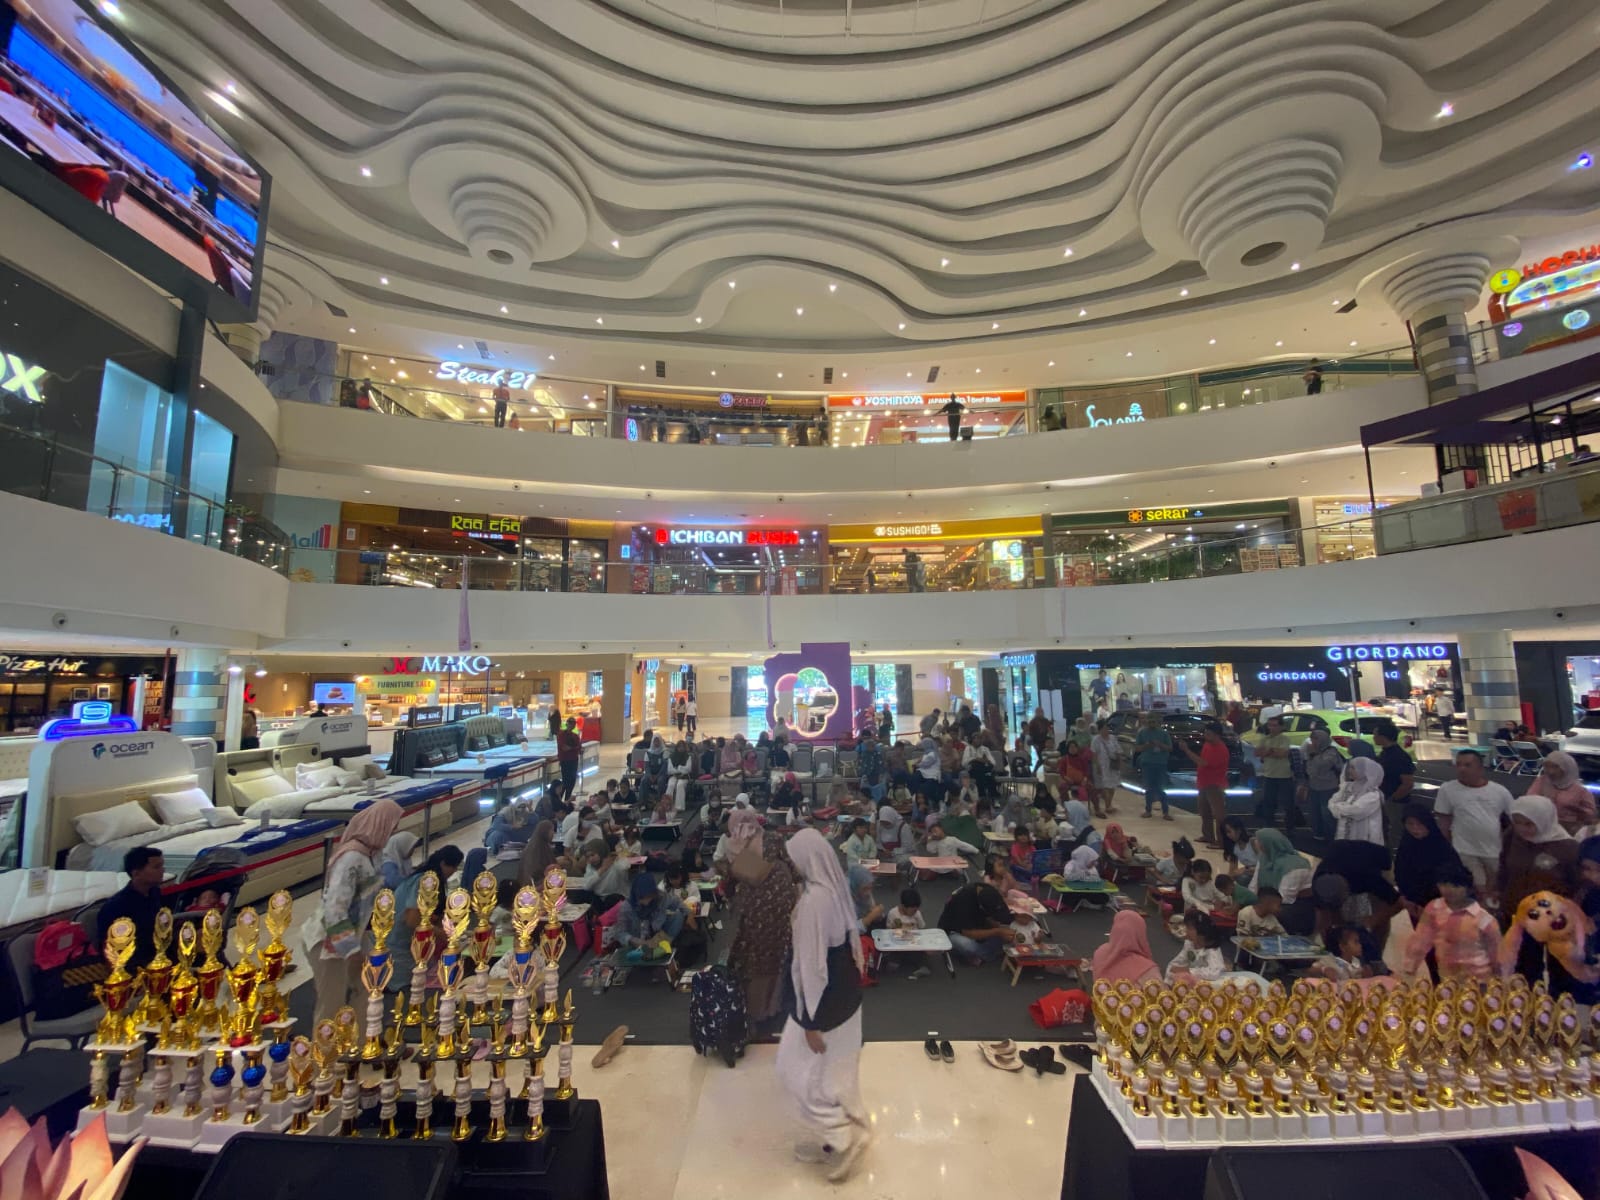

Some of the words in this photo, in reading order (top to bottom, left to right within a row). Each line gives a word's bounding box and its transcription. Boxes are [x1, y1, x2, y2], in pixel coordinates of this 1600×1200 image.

[436, 361, 505, 386] Steak
[507, 371, 537, 391] 21
[1146, 508, 1189, 521] sekar
[670, 529, 743, 544] ICHIBAN
[1326, 645, 1447, 662] GIORDANO
[421, 656, 491, 675] MAKO
[1257, 671, 1326, 681] GIORDANO
[110, 741, 154, 753] ocean
